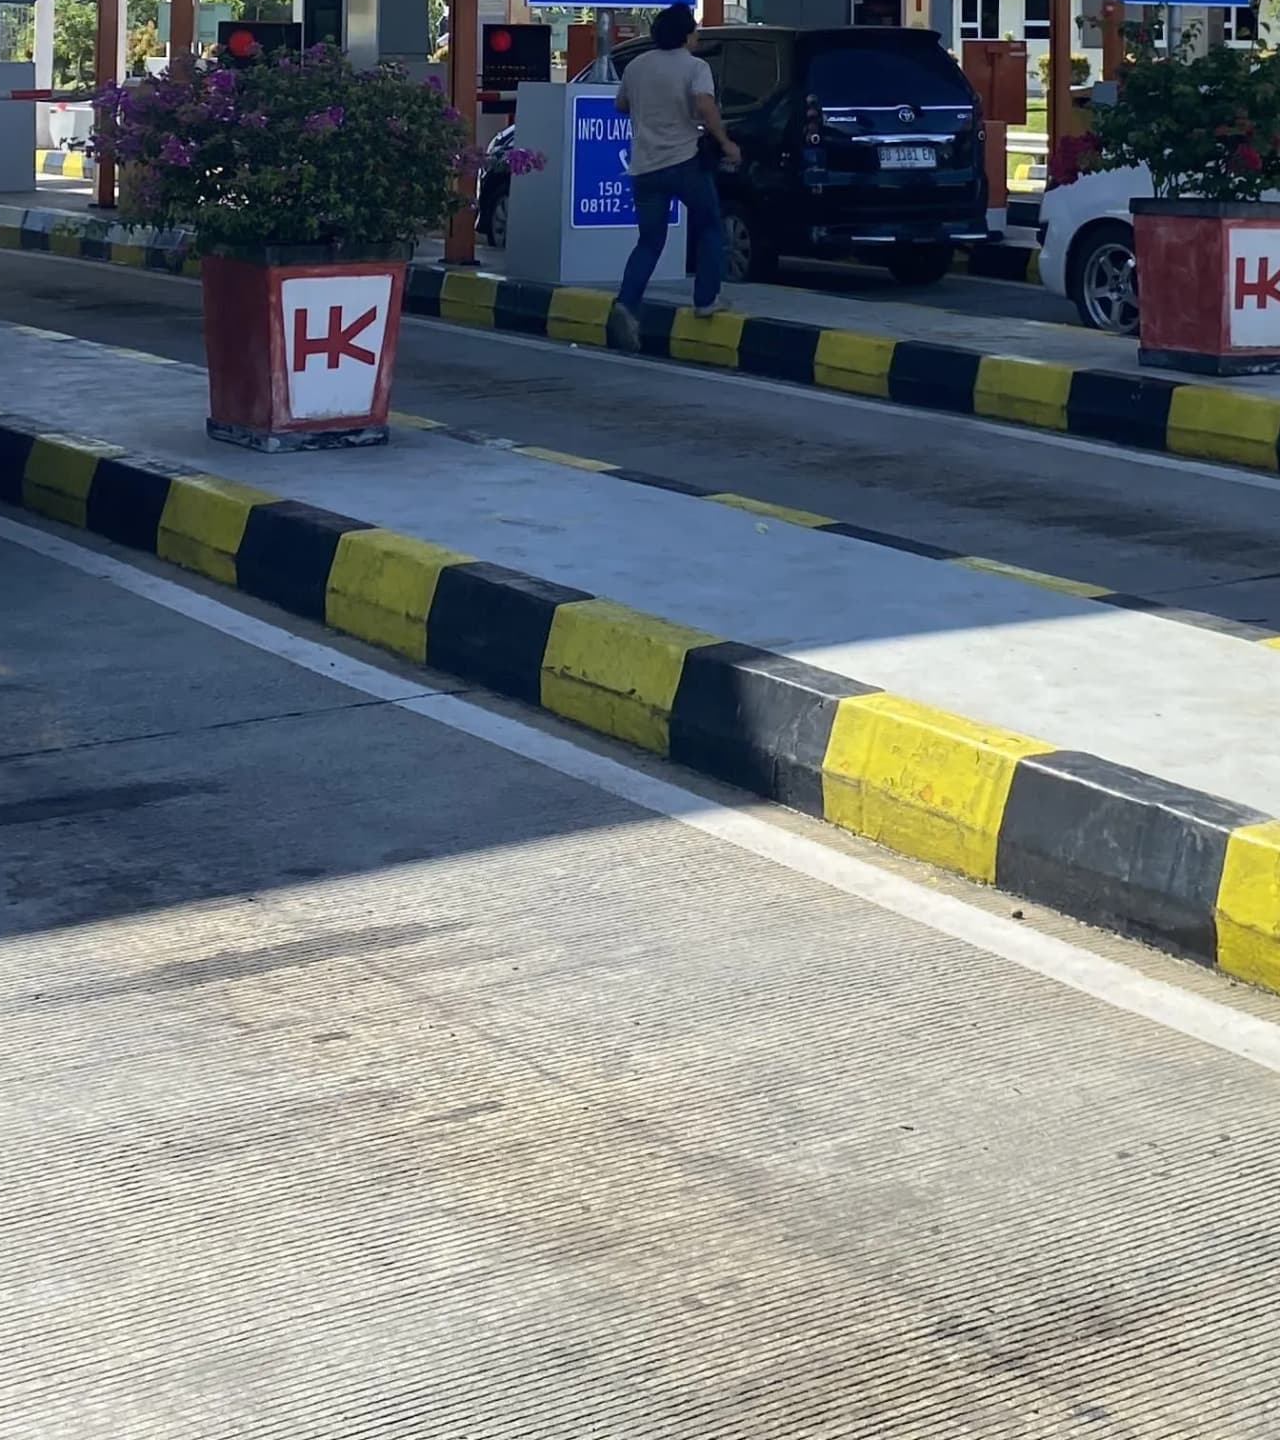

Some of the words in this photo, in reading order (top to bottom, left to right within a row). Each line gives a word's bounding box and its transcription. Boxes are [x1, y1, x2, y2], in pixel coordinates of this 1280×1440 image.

[578, 118, 604, 140] INFO
[607, 118, 633, 140] LAYA
[598, 181, 622, 196] 150
[580, 198, 621, 213] 08112
[293, 305, 377, 372] HK
